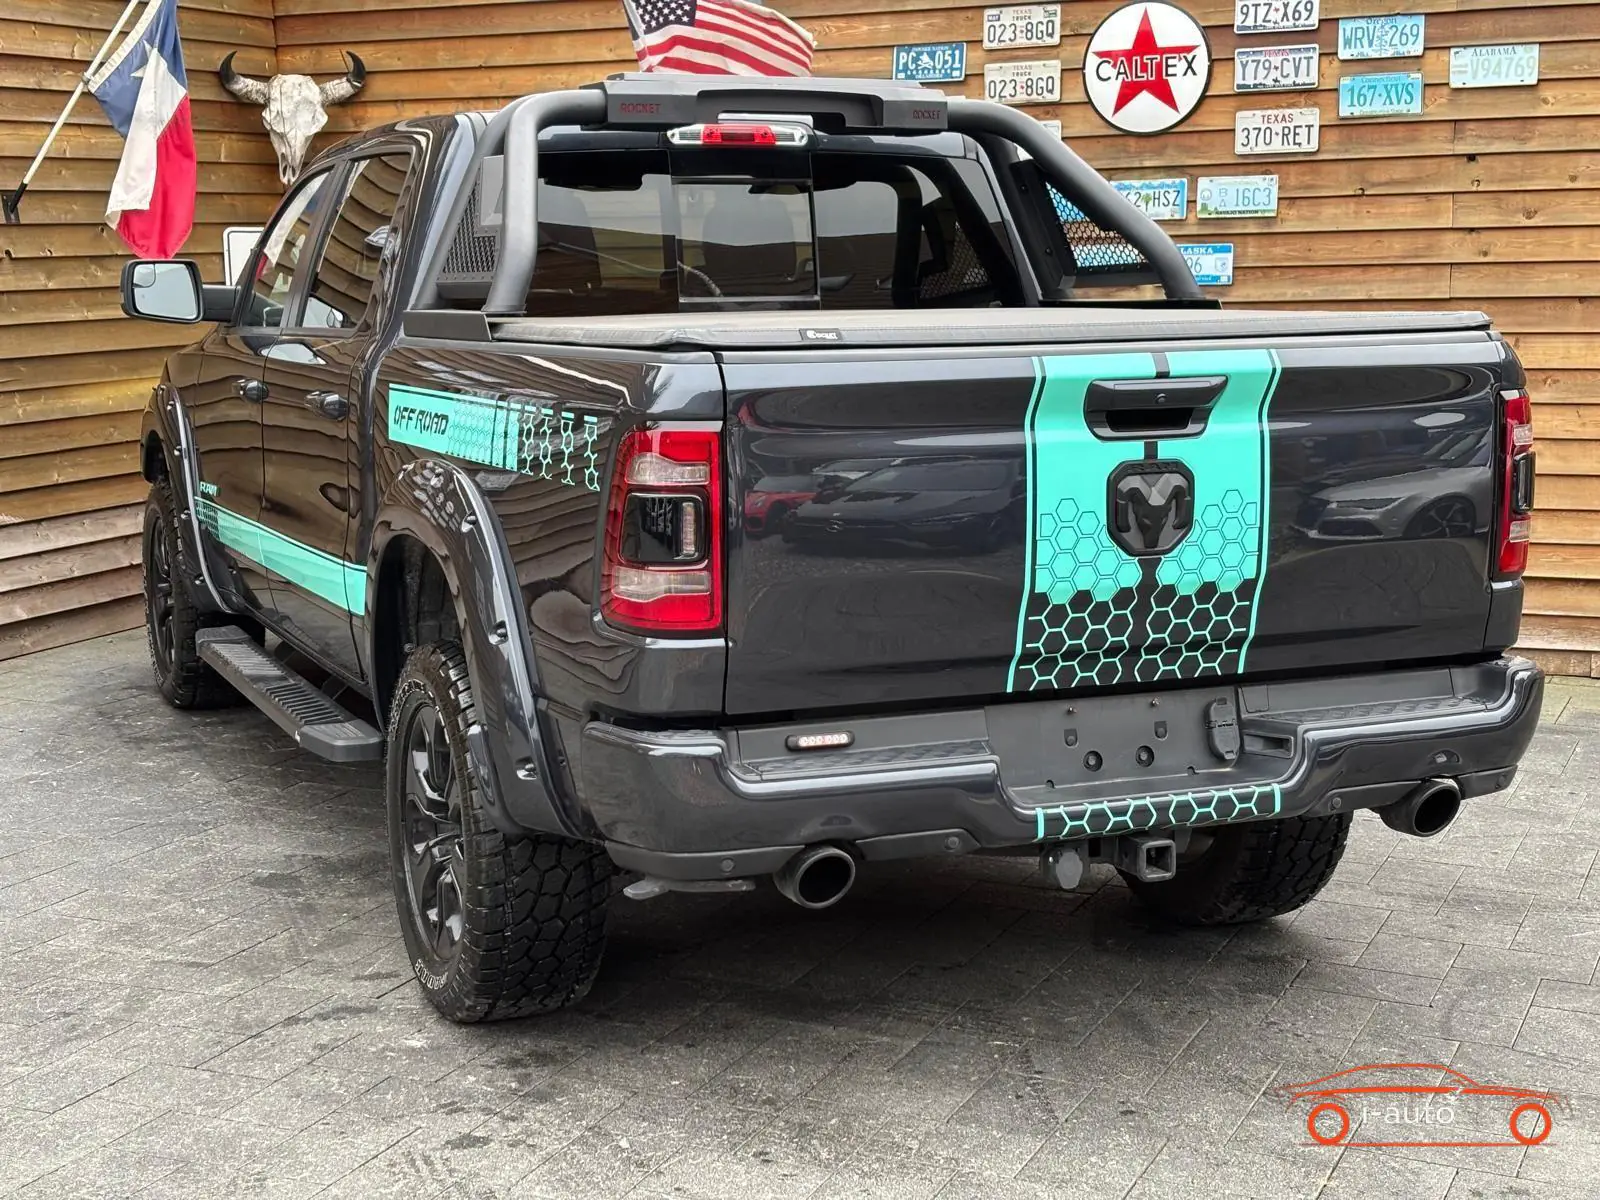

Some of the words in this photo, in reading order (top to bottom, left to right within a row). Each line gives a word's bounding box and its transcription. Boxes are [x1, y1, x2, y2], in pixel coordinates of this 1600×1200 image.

[1096, 54, 1198, 82] CALTEX
[619, 102, 661, 114] ROCKET
[912, 109, 940, 120] ROCKET
[1261, 113, 1294, 124] TEXAS
[1153, 190, 1181, 208] HSZ
[1180, 246, 1214, 255] LASKA
[414, 409, 449, 436] ROAD
[200, 481, 217, 497] RAM
